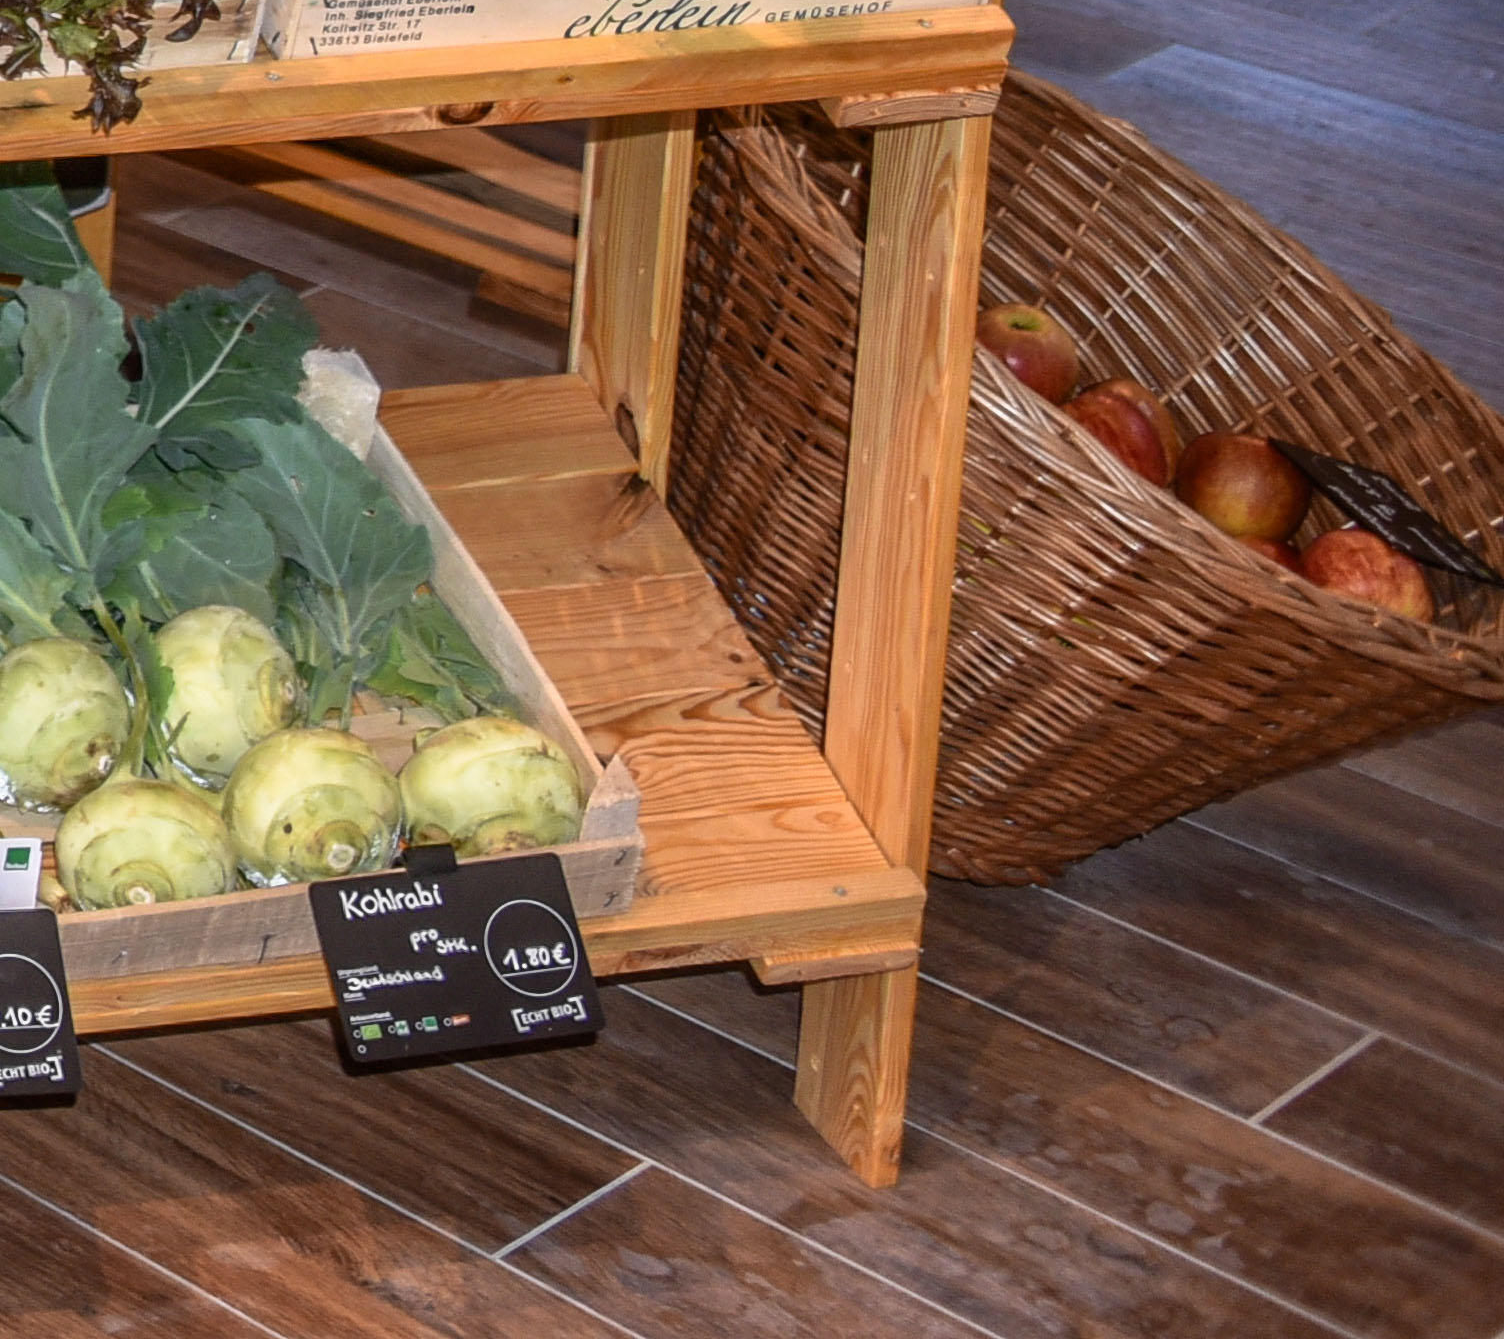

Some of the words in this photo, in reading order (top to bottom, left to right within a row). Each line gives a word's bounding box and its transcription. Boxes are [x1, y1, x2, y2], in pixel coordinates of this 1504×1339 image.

[325, 13, 349, 21] Inh.
[354, 7, 415, 20] Siegfried
[419, 5, 475, 16] Eberlein
[765, 0, 893, 23] GEMÜSEHOF
[322, 24, 375, 34] Kollwitz
[378, 22, 400, 30] Str.
[407, 20, 421, 29] 17
[319, 36, 359, 46] 33613
[363, 32, 423, 44] Bielefeld
[339, 881, 443, 920] Kohlrabi
[410, 928, 439, 951] pro
[347, 965, 444, 992] Deutschland
